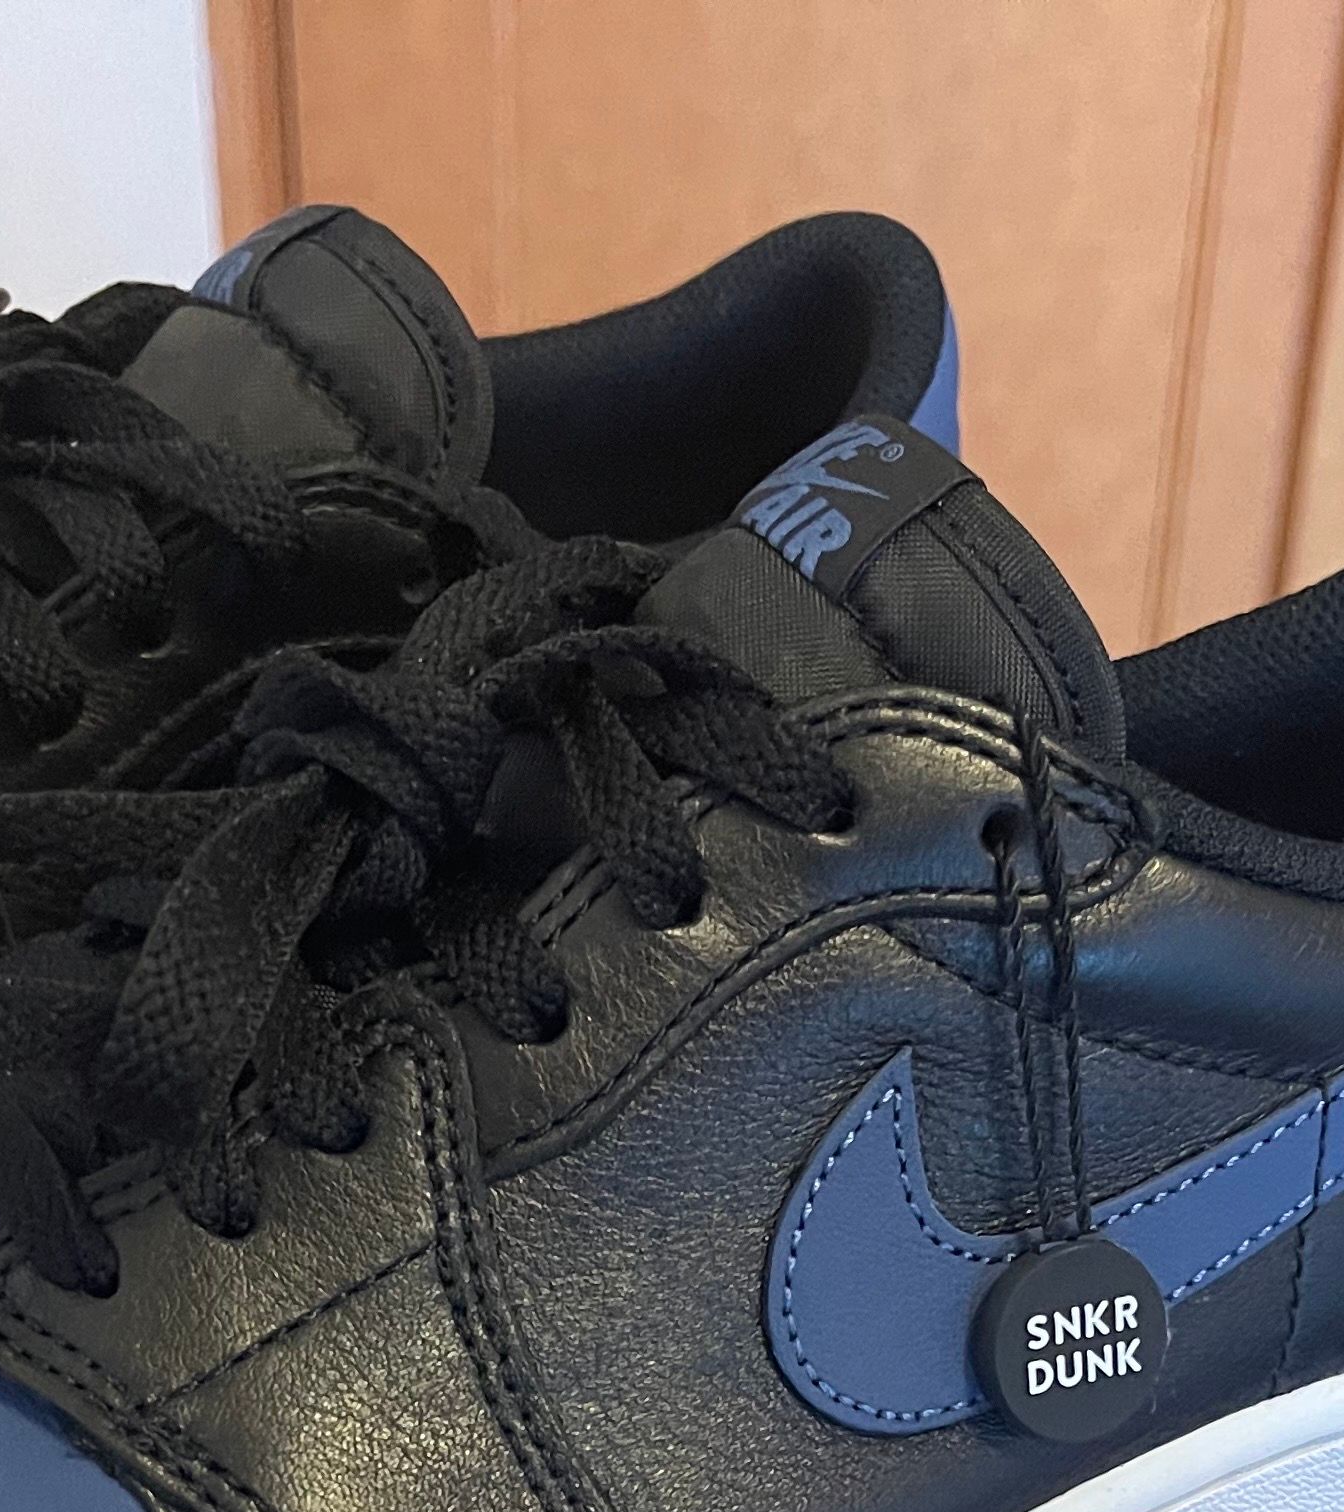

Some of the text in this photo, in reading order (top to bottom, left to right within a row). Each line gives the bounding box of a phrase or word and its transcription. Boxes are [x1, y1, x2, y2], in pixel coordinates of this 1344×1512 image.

[741, 484, 853, 580] AIR
[1026, 1294, 1139, 1350] SNKR
[1027, 1337, 1142, 1396] DUNK
